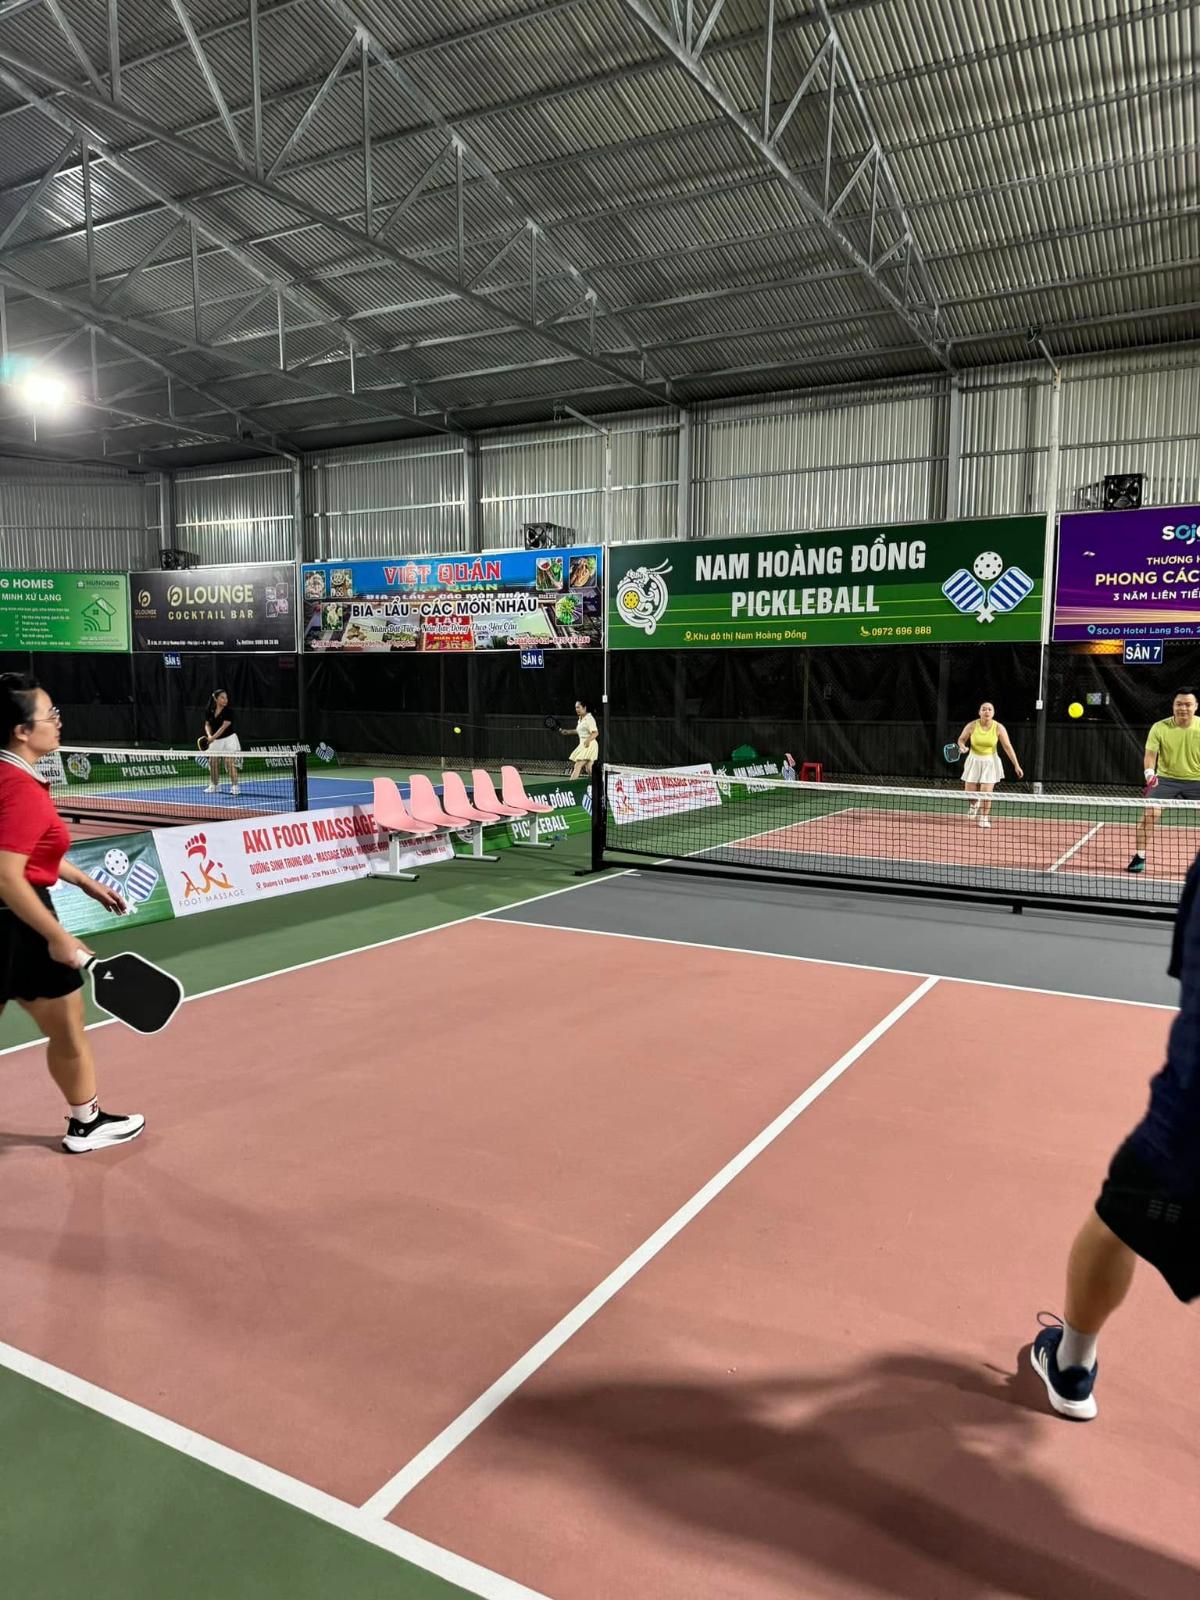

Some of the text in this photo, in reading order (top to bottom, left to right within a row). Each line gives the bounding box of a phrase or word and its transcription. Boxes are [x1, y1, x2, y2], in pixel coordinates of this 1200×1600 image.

[695, 534, 926, 581] NAM HOÀNG ĐỒNG
[1147, 555, 1193, 566] THƯƠNG
[383, 558, 501, 586] VIỆT QUÁN
[1095, 572, 1157, 586] PHONG
[0, 578, 54, 588] G HOMES
[38, 593, 61, 602] LẠNG
[186, 584, 254, 604] LOUNGE
[731, 585, 880, 617] PICKLEBALL
[1113, 587, 1200, 601] 3 NĂM LIÊN TIẾ
[352, 605, 373, 617] BIA
[385, 598, 409, 617] LẨU
[421, 599, 453, 616] CÁC
[457, 598, 491, 614] MÓN
[496, 596, 538, 616] NHẬU
[168, 611, 225, 620] COCKTAIL
[231, 609, 254, 619] BAR
[693, 632, 707, 640] Khu
[735, 631, 752, 640] Nam
[756, 630, 781, 642] Hoàng
[872, 624, 931, 636] 0972 696 888
[1096, 626, 1120, 634] SOJO
[1123, 626, 1146, 634] Hotel
[1149, 626, 1171, 635] Lang
[1174, 626, 1194, 634] Son,
[523, 653, 544, 665] SÂN 6
[1126, 644, 1161, 660] SÂN 7
[122, 764, 178, 776] PICKLEBALL
[242, 829, 272, 854] AKI
[272, 823, 312, 849] FOOT
[312, 814, 378, 843] MASSAGE
[511, 815, 569, 839] PICLEBALL
[270, 859, 284, 871] SINH
[316, 850, 340, 862] MASSAGE
[179, 889, 245, 907] FOOT MASSAGE
